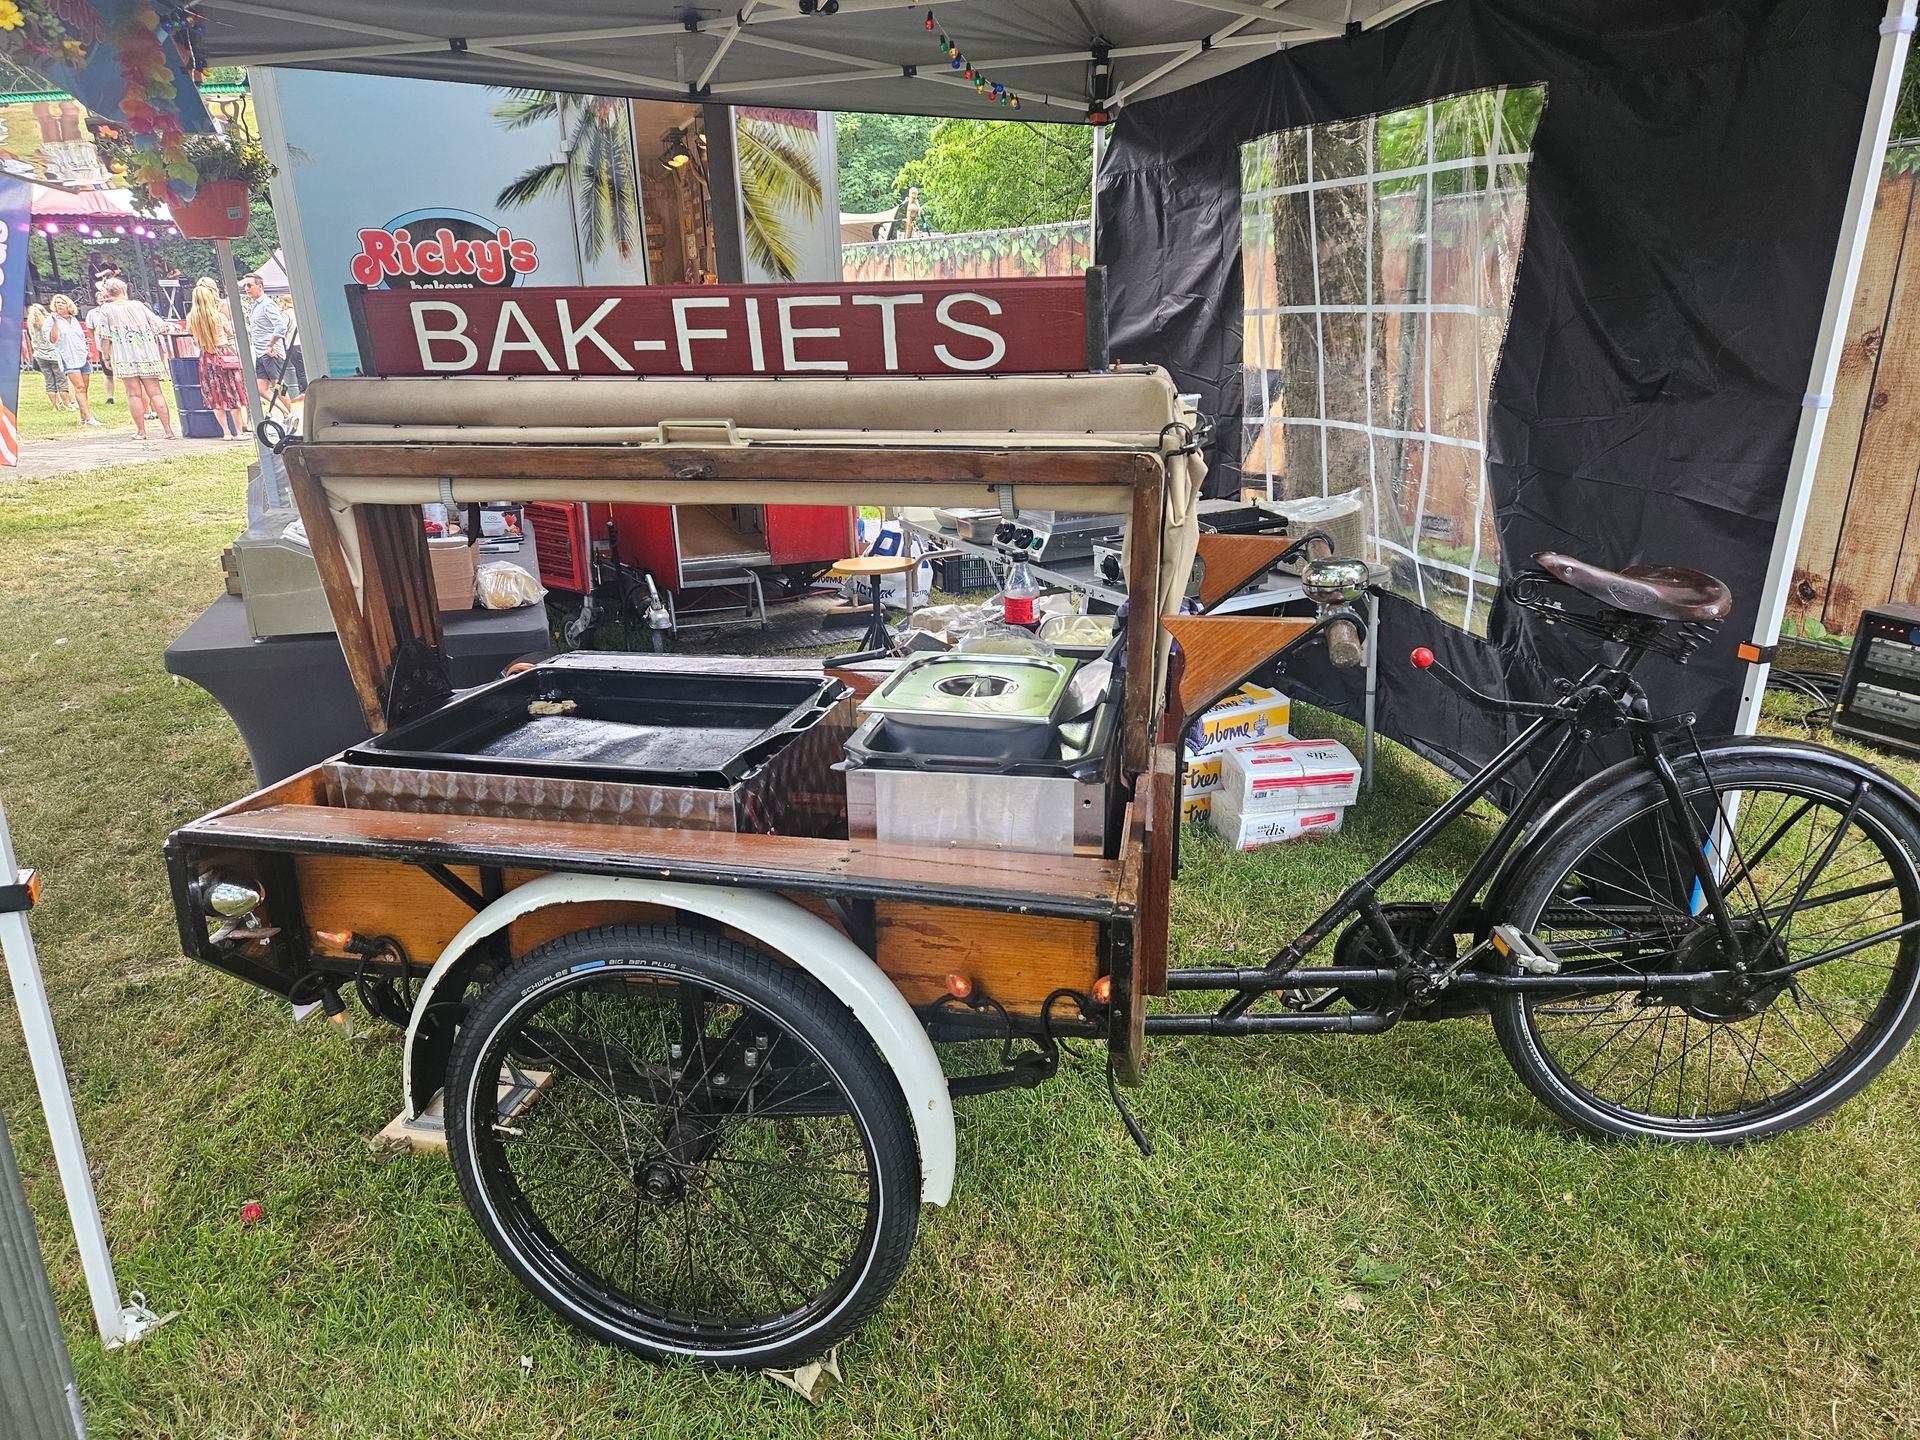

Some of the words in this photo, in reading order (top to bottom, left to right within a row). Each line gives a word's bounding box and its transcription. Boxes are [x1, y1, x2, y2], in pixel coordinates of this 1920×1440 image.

[351, 228, 540, 286] Ricky's
[409, 292, 1007, 372] BAK-FIETS
[1265, 822, 1286, 836] dis
[520, 968, 568, 997] SCHWALBE
[651, 961, 677, 969] PLUS
